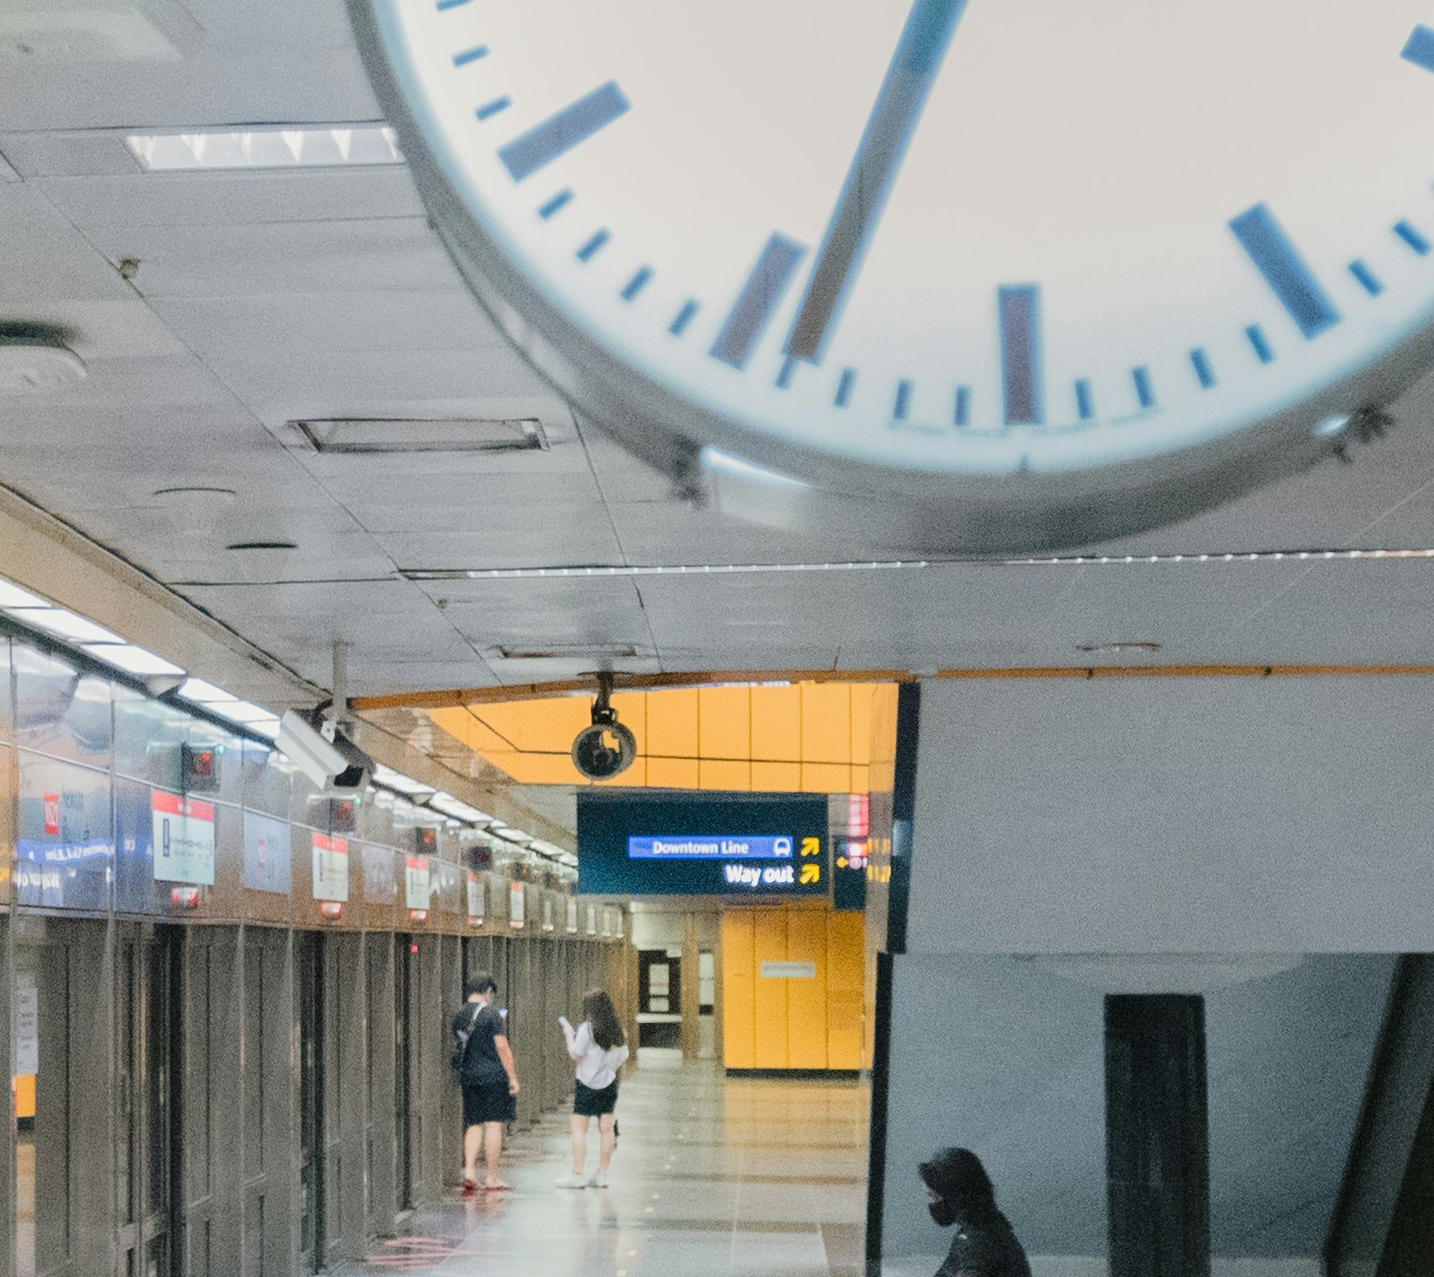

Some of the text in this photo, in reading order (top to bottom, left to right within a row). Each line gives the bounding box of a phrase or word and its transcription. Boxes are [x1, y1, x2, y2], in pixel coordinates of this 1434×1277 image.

[652, 840, 749, 855] Downtown Line
[725, 864, 794, 887] Way out
